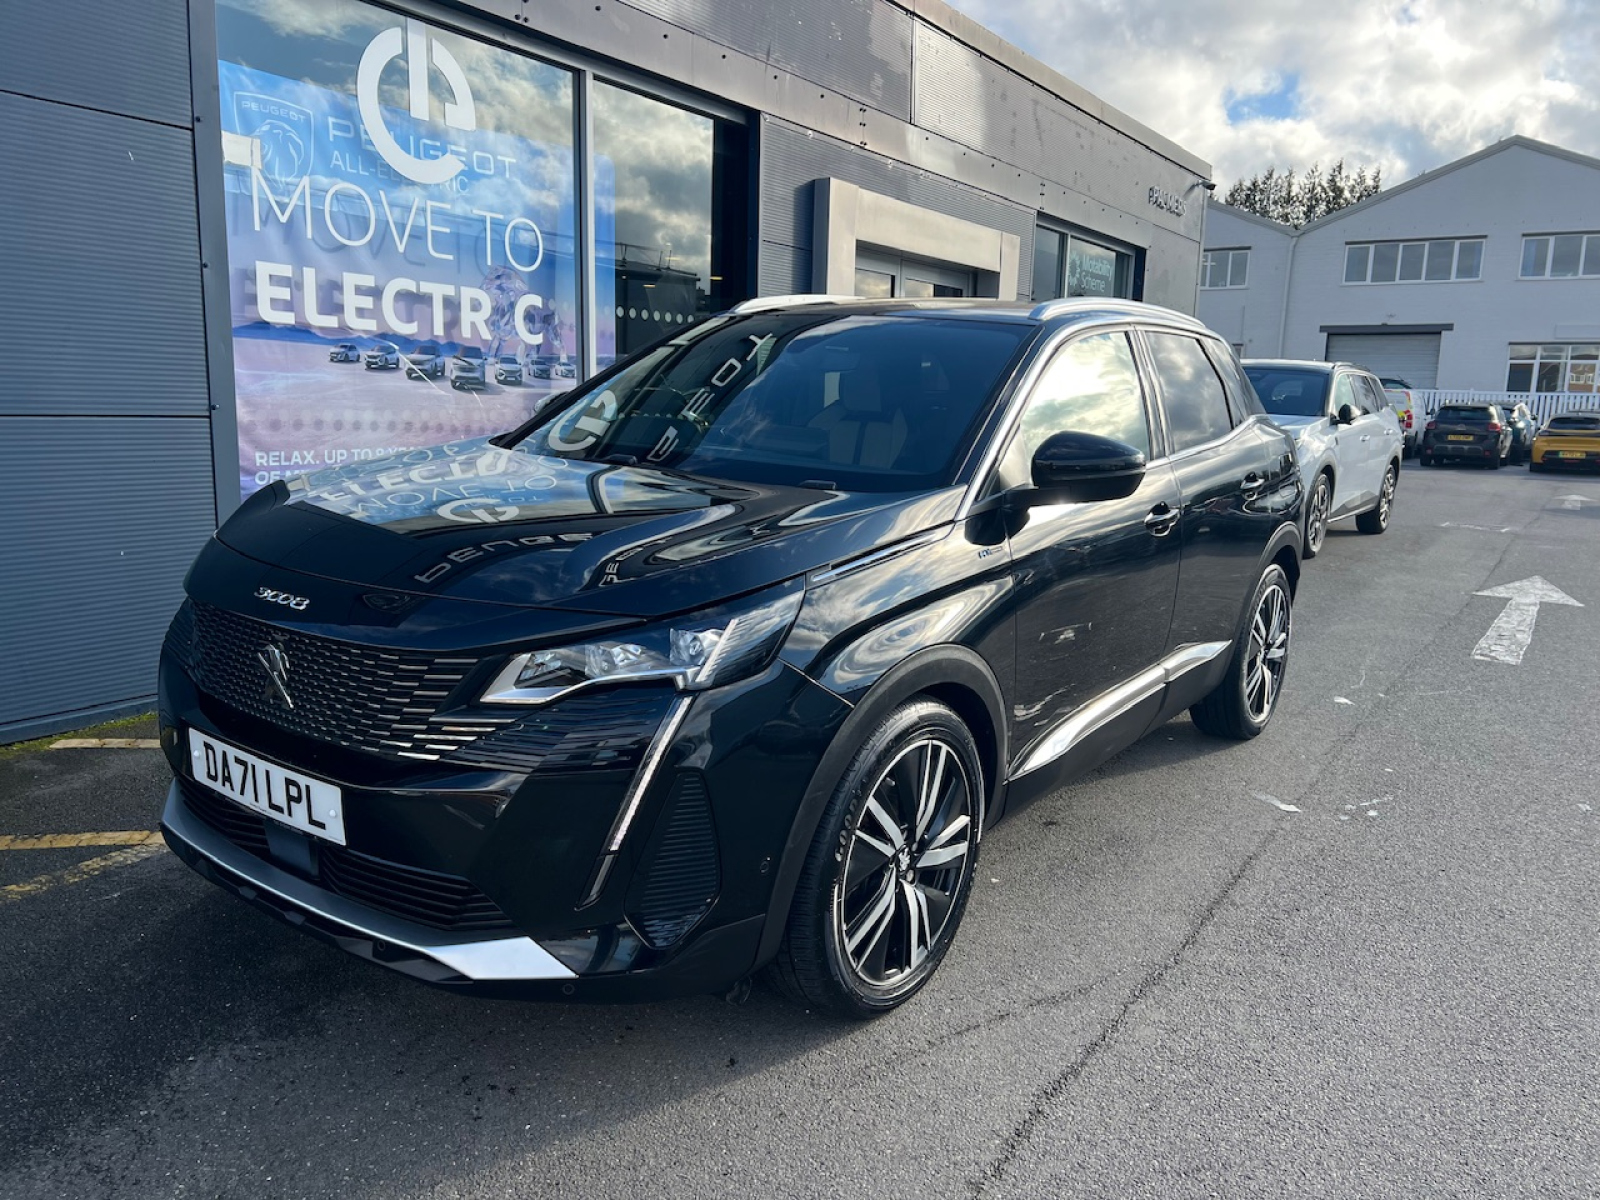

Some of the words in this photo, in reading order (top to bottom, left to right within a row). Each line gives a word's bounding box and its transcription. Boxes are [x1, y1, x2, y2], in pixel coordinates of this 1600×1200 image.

[241, 100, 306, 123] PEUGEOT
[251, 167, 453, 261] MOVE
[473, 209, 543, 272] TO
[1082, 253, 1113, 281] Motability
[1081, 271, 1106, 293] Scheme
[255, 449, 321, 467] RELAX.
[325, 449, 348, 464] UP
[253, 586, 310, 611] 3008
[203, 740, 259, 804] DA71
[264, 769, 327, 831] LPL
